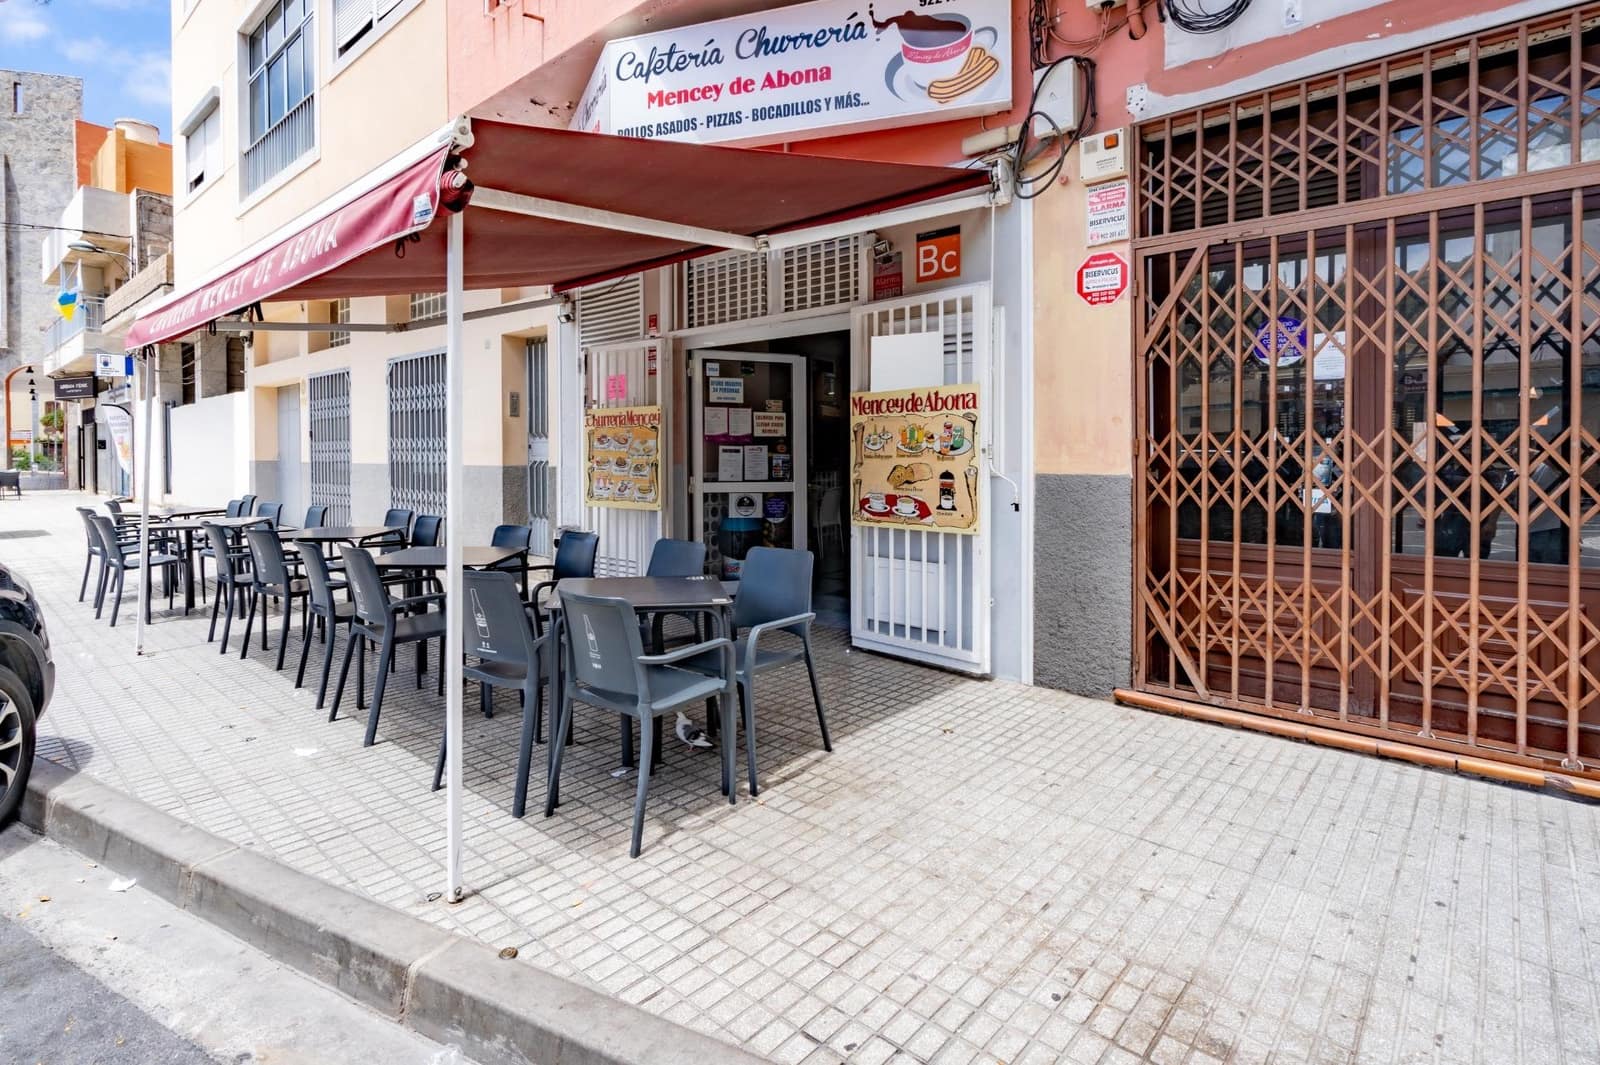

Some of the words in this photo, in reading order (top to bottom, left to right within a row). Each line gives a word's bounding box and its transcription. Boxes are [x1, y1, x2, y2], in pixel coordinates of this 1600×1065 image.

[616, 38, 724, 84] Cafetería
[735, 11, 868, 60] Churrería
[647, 83, 724, 109] Mencey
[729, 77, 755, 95] de
[760, 65, 832, 91] Abona
[655, 117, 697, 136] ASADOS
[706, 110, 743, 128] PIZZAS
[751, 98, 821, 122] BOCADILLOS
[824, 97, 832, 111] Y
[834, 91, 870, 110] MÁS...
[1089, 214, 1126, 228] BISERVICUS
[1090, 200, 1125, 214] ALARMA
[252, 254, 275, 289] DE
[278, 213, 343, 279] ABONA
[919, 245, 957, 277] Bc
[1084, 267, 1119, 278] BISERVICUS
[851, 396, 905, 416] Mencey
[905, 392, 923, 413] de
[923, 390, 978, 412] Abona
[626, 410, 661, 426] Mencey
